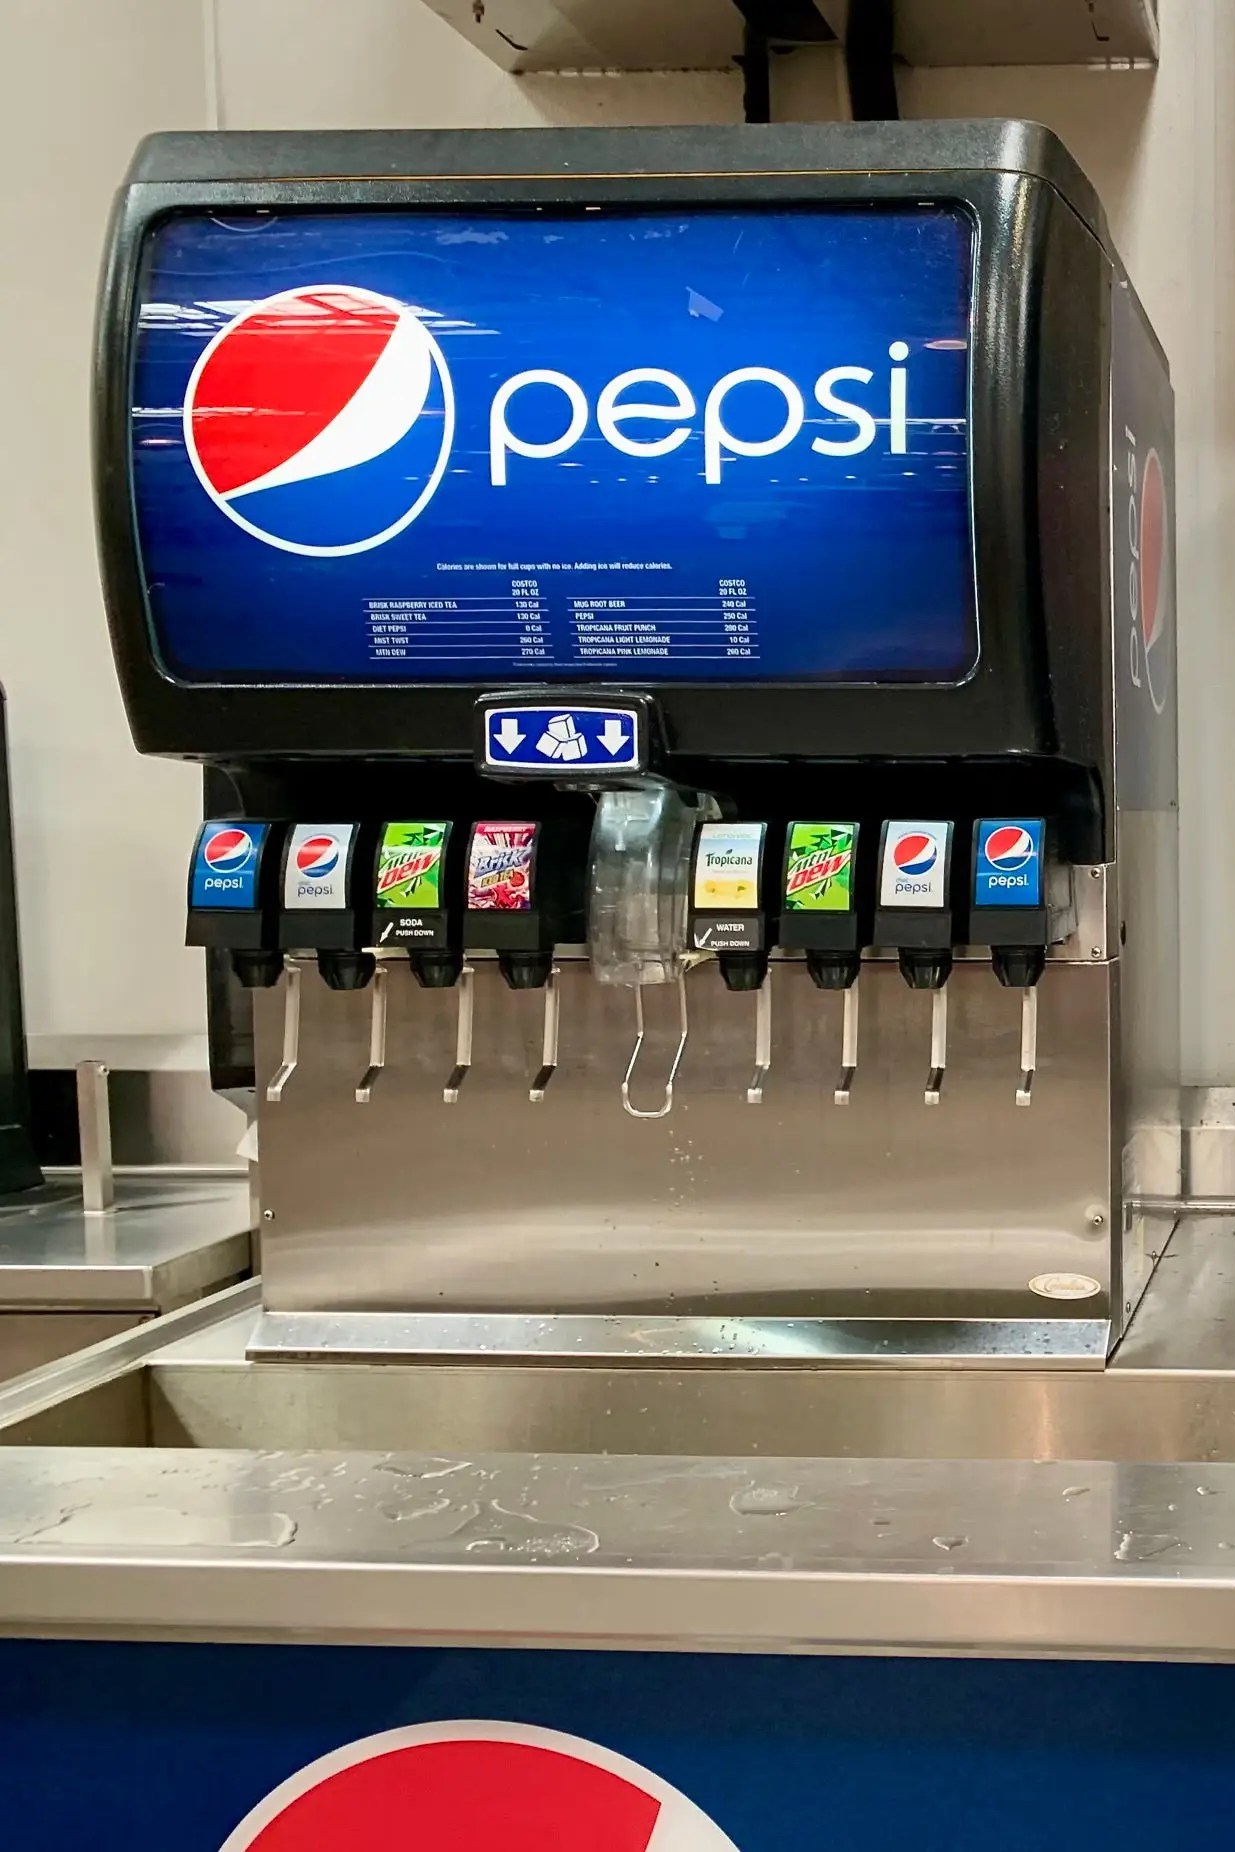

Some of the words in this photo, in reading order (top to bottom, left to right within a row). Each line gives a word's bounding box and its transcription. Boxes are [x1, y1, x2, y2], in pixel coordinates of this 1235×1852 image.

[490, 341, 908, 486] pepsi
[1125, 426, 1141, 688] pepsi
[706, 853, 752, 867] Tropicana
[205, 877, 243, 891] pepsi
[895, 882, 932, 894] pepsi
[989, 874, 1029, 888] pepsi
[297, 884, 334, 897] pepsi
